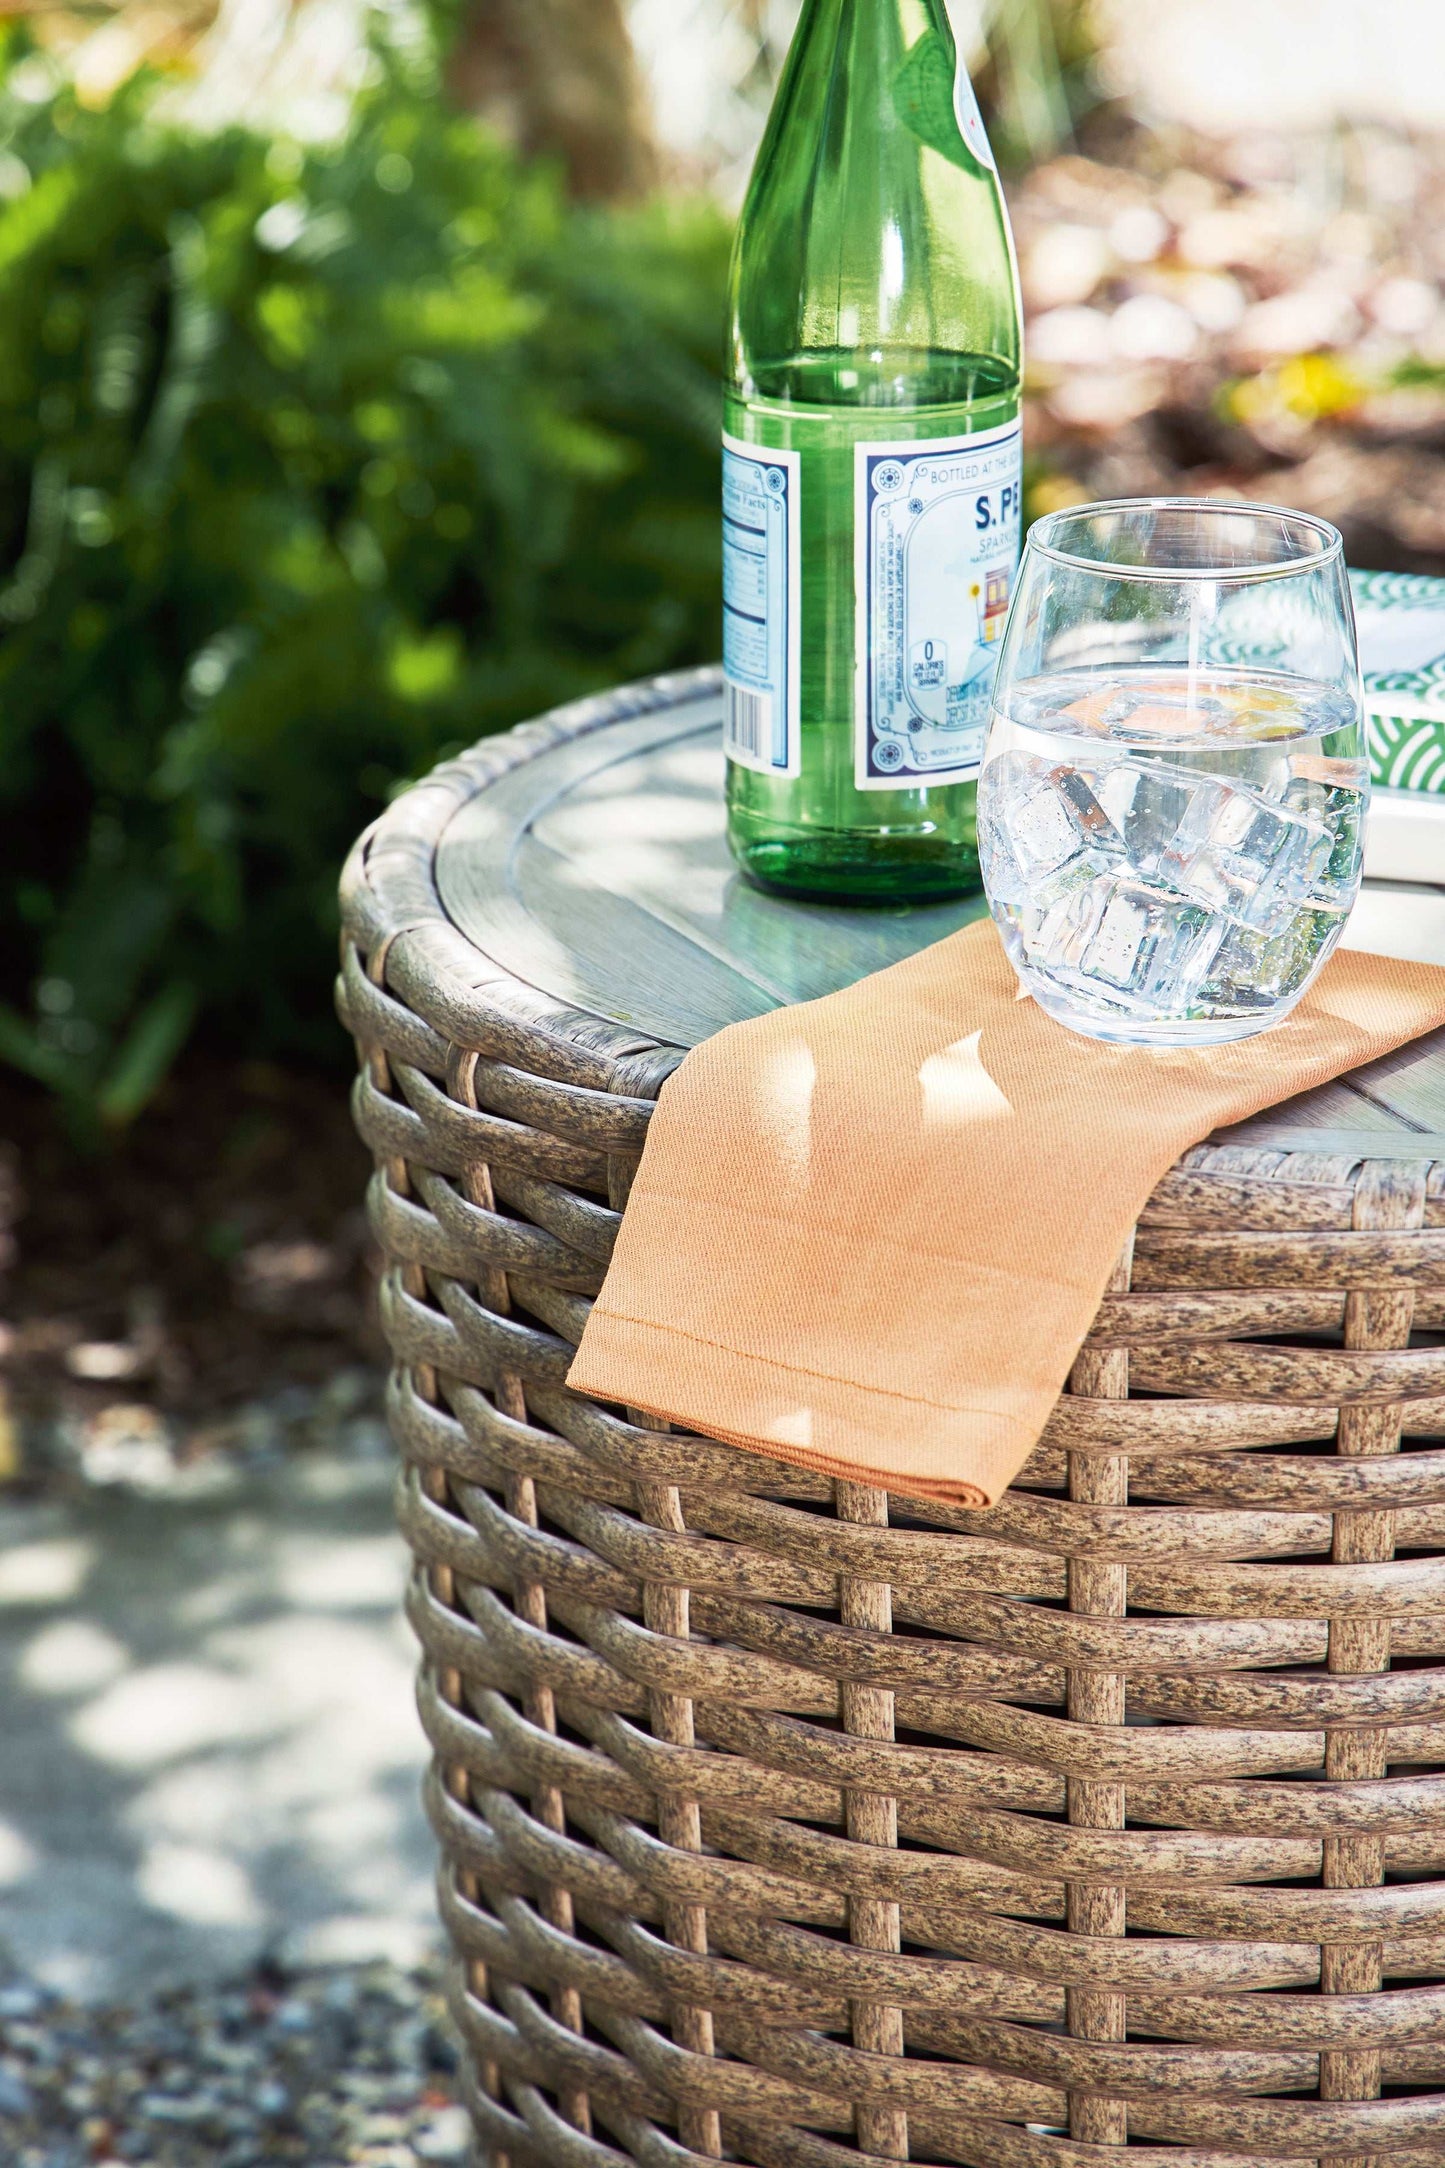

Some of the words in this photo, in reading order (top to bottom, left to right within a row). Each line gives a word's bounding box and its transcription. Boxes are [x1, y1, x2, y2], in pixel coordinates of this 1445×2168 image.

[931, 464, 978, 484] BOTTLED
[924, 641, 934, 660] 0
[913, 660, 944, 672] CALORIES
